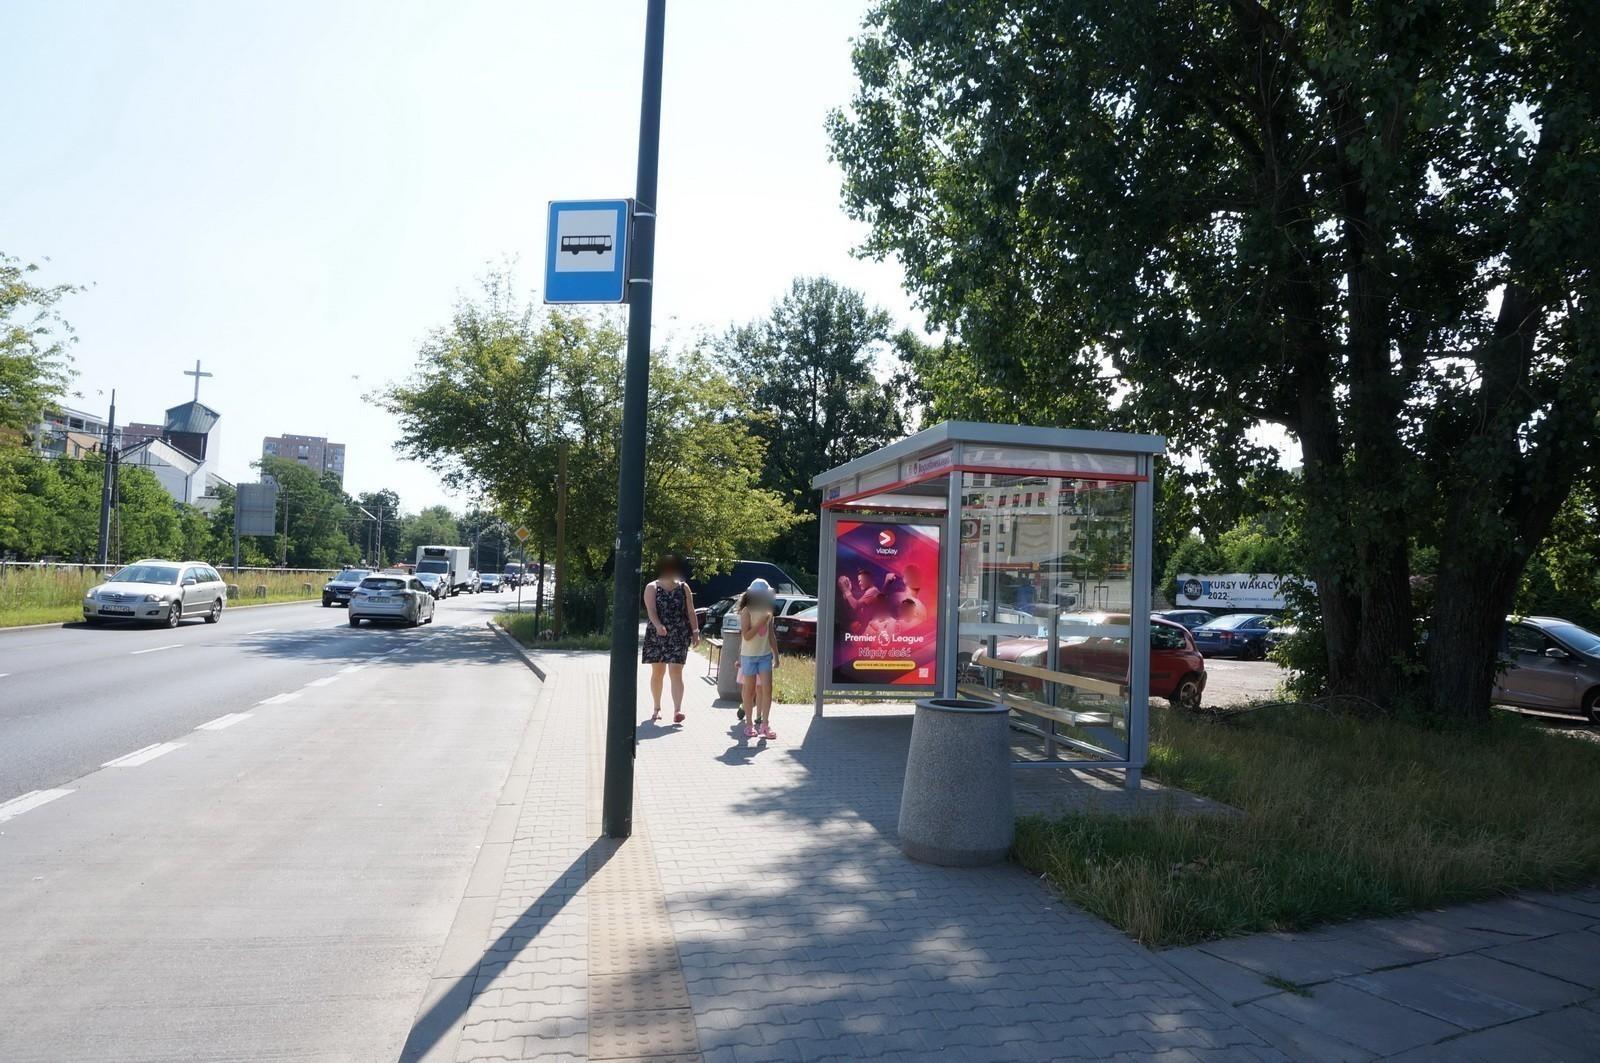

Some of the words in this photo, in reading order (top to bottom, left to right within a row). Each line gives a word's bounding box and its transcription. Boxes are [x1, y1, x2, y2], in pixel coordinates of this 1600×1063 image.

[1208, 581, 1236, 590] KURSY
[1208, 592, 1228, 601] 2022
[844, 633, 877, 643] Premier
[892, 634, 924, 645] League
[858, 647, 887, 659] Nigdy
[888, 647, 912, 658] dość
